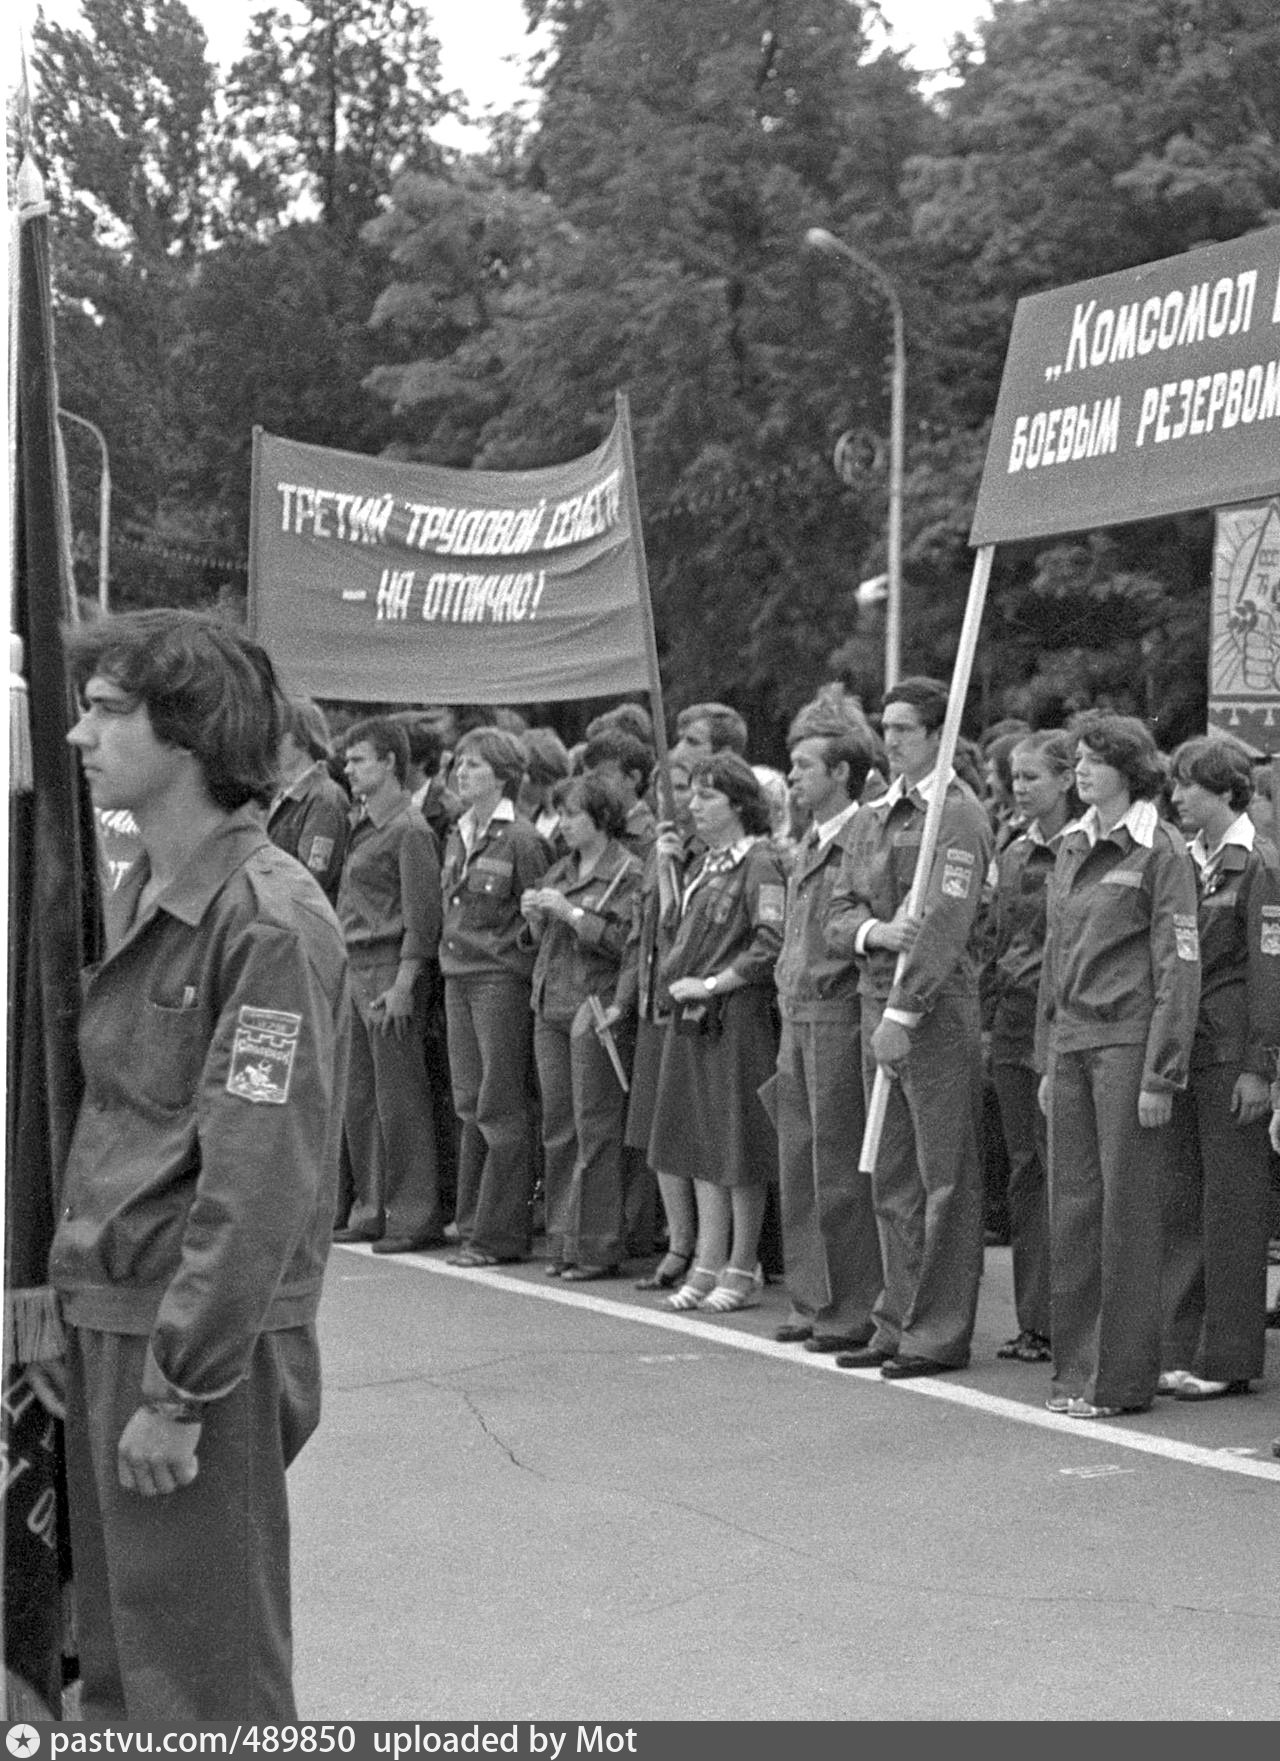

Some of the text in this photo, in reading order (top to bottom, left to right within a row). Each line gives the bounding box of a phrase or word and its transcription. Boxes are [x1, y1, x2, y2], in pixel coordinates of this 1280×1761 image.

[1007, 395, 1122, 474] БОЕВЫМ
[277, 481, 394, 545] ТРЕТИЙ
[376, 568, 416, 622] НА
[422, 569, 546, 623] ОТЛИЧНО!
